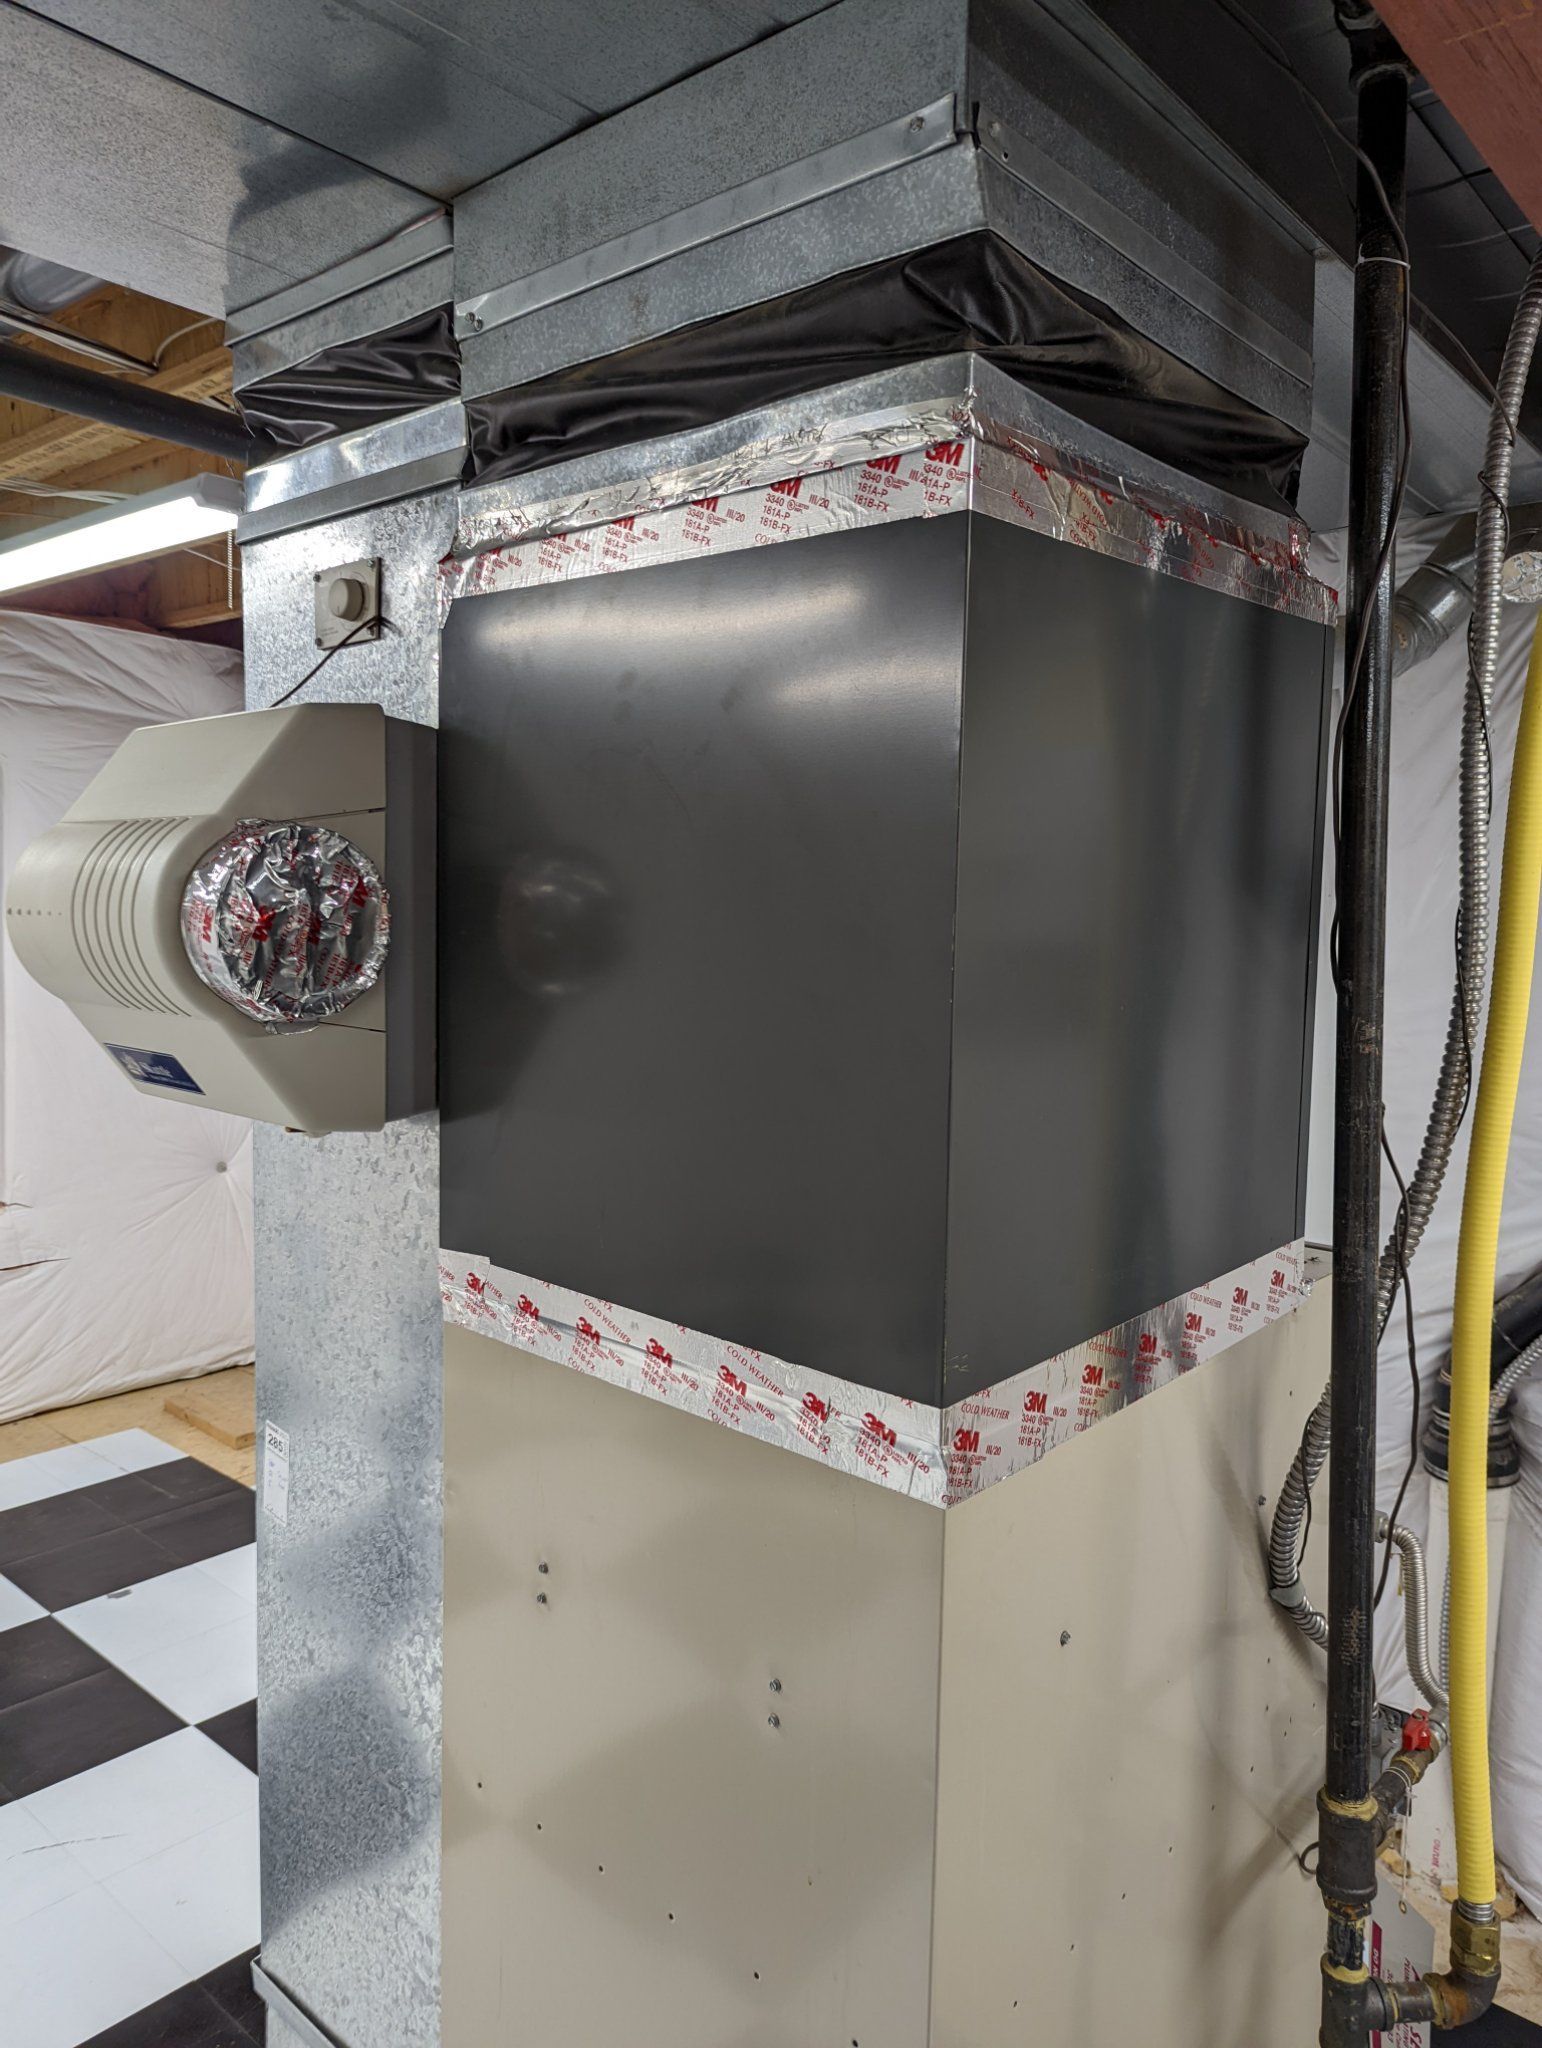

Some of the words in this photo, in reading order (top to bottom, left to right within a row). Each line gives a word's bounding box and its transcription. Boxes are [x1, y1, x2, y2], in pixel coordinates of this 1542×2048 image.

[925, 441, 965, 466] 3M
[861, 470, 882, 483] 3340
[858, 482, 888, 498] 181A-P
[765, 494, 785, 506] 3340
[809, 494, 829, 509] III/20
[854, 494, 890, 513] 181B-FX
[686, 507, 704, 520] 3340
[726, 508, 745, 522] III/20
[763, 505, 790, 520] 181A-P
[606, 526, 622, 538] 3340
[684, 519, 710, 533] 181A-P
[760, 517, 791, 534] 181B-FX
[682, 529, 711, 546] 181B-FX
[467, 1272, 486, 1295] 3M
[1271, 1270, 1285, 1288] 3M
[1233, 1287, 1248, 1306] 3M
[518, 1294, 539, 1320] 3M
[576, 1317, 600, 1345] 3M
[584, 1299, 601, 1317] COLD
[601, 1315, 631, 1344] WEATHER
[1185, 1312, 1202, 1332] 3M
[1138, 1333, 1157, 1354] 3M
[572, 1346, 595, 1371] 181B-FX
[608, 1349, 624, 1367] III/20
[646, 1338, 673, 1369] 3M
[643, 1360, 667, 1382] 181A-P
[727, 1345, 748, 1366] COLD
[749, 1364, 784, 1398] WEATHER
[1082, 1364, 1104, 1386] 3M
[641, 1368, 668, 1396] 181B-FX
[681, 1372, 699, 1391] III/20
[716, 1379, 734, 1397] 3340
[718, 1365, 747, 1397] 3M
[1080, 1386, 1092, 1395] 3340
[715, 1387, 740, 1411] 181A-P
[802, 1392, 829, 1424] 3M
[1024, 1391, 1047, 1414] 3M
[712, 1396, 740, 1425] 181B-FX
[756, 1401, 775, 1421] III/20
[800, 1407, 819, 1426] 3340
[961, 1402, 979, 1415] COLD
[981, 1405, 1010, 1420] WEATHER
[1022, 1413, 1036, 1424] 3340
[859, 1427, 880, 1447] 3340
[861, 1412, 897, 1447] 3M
[1020, 1426, 1041, 1436] 181A-P
[268, 1433, 283, 1452] 285
[796, 1424, 829, 1455] 181B-FX
[858, 1436, 888, 1462] 181A-P
[953, 1428, 980, 1453] 3M
[1018, 1436, 1041, 1447] 181B-FX
[951, 1454, 967, 1464] 3340
[986, 1445, 1001, 1456] III/20
[855, 1445, 890, 1478] 181B-FX
[907, 1452, 930, 1474] III/20
